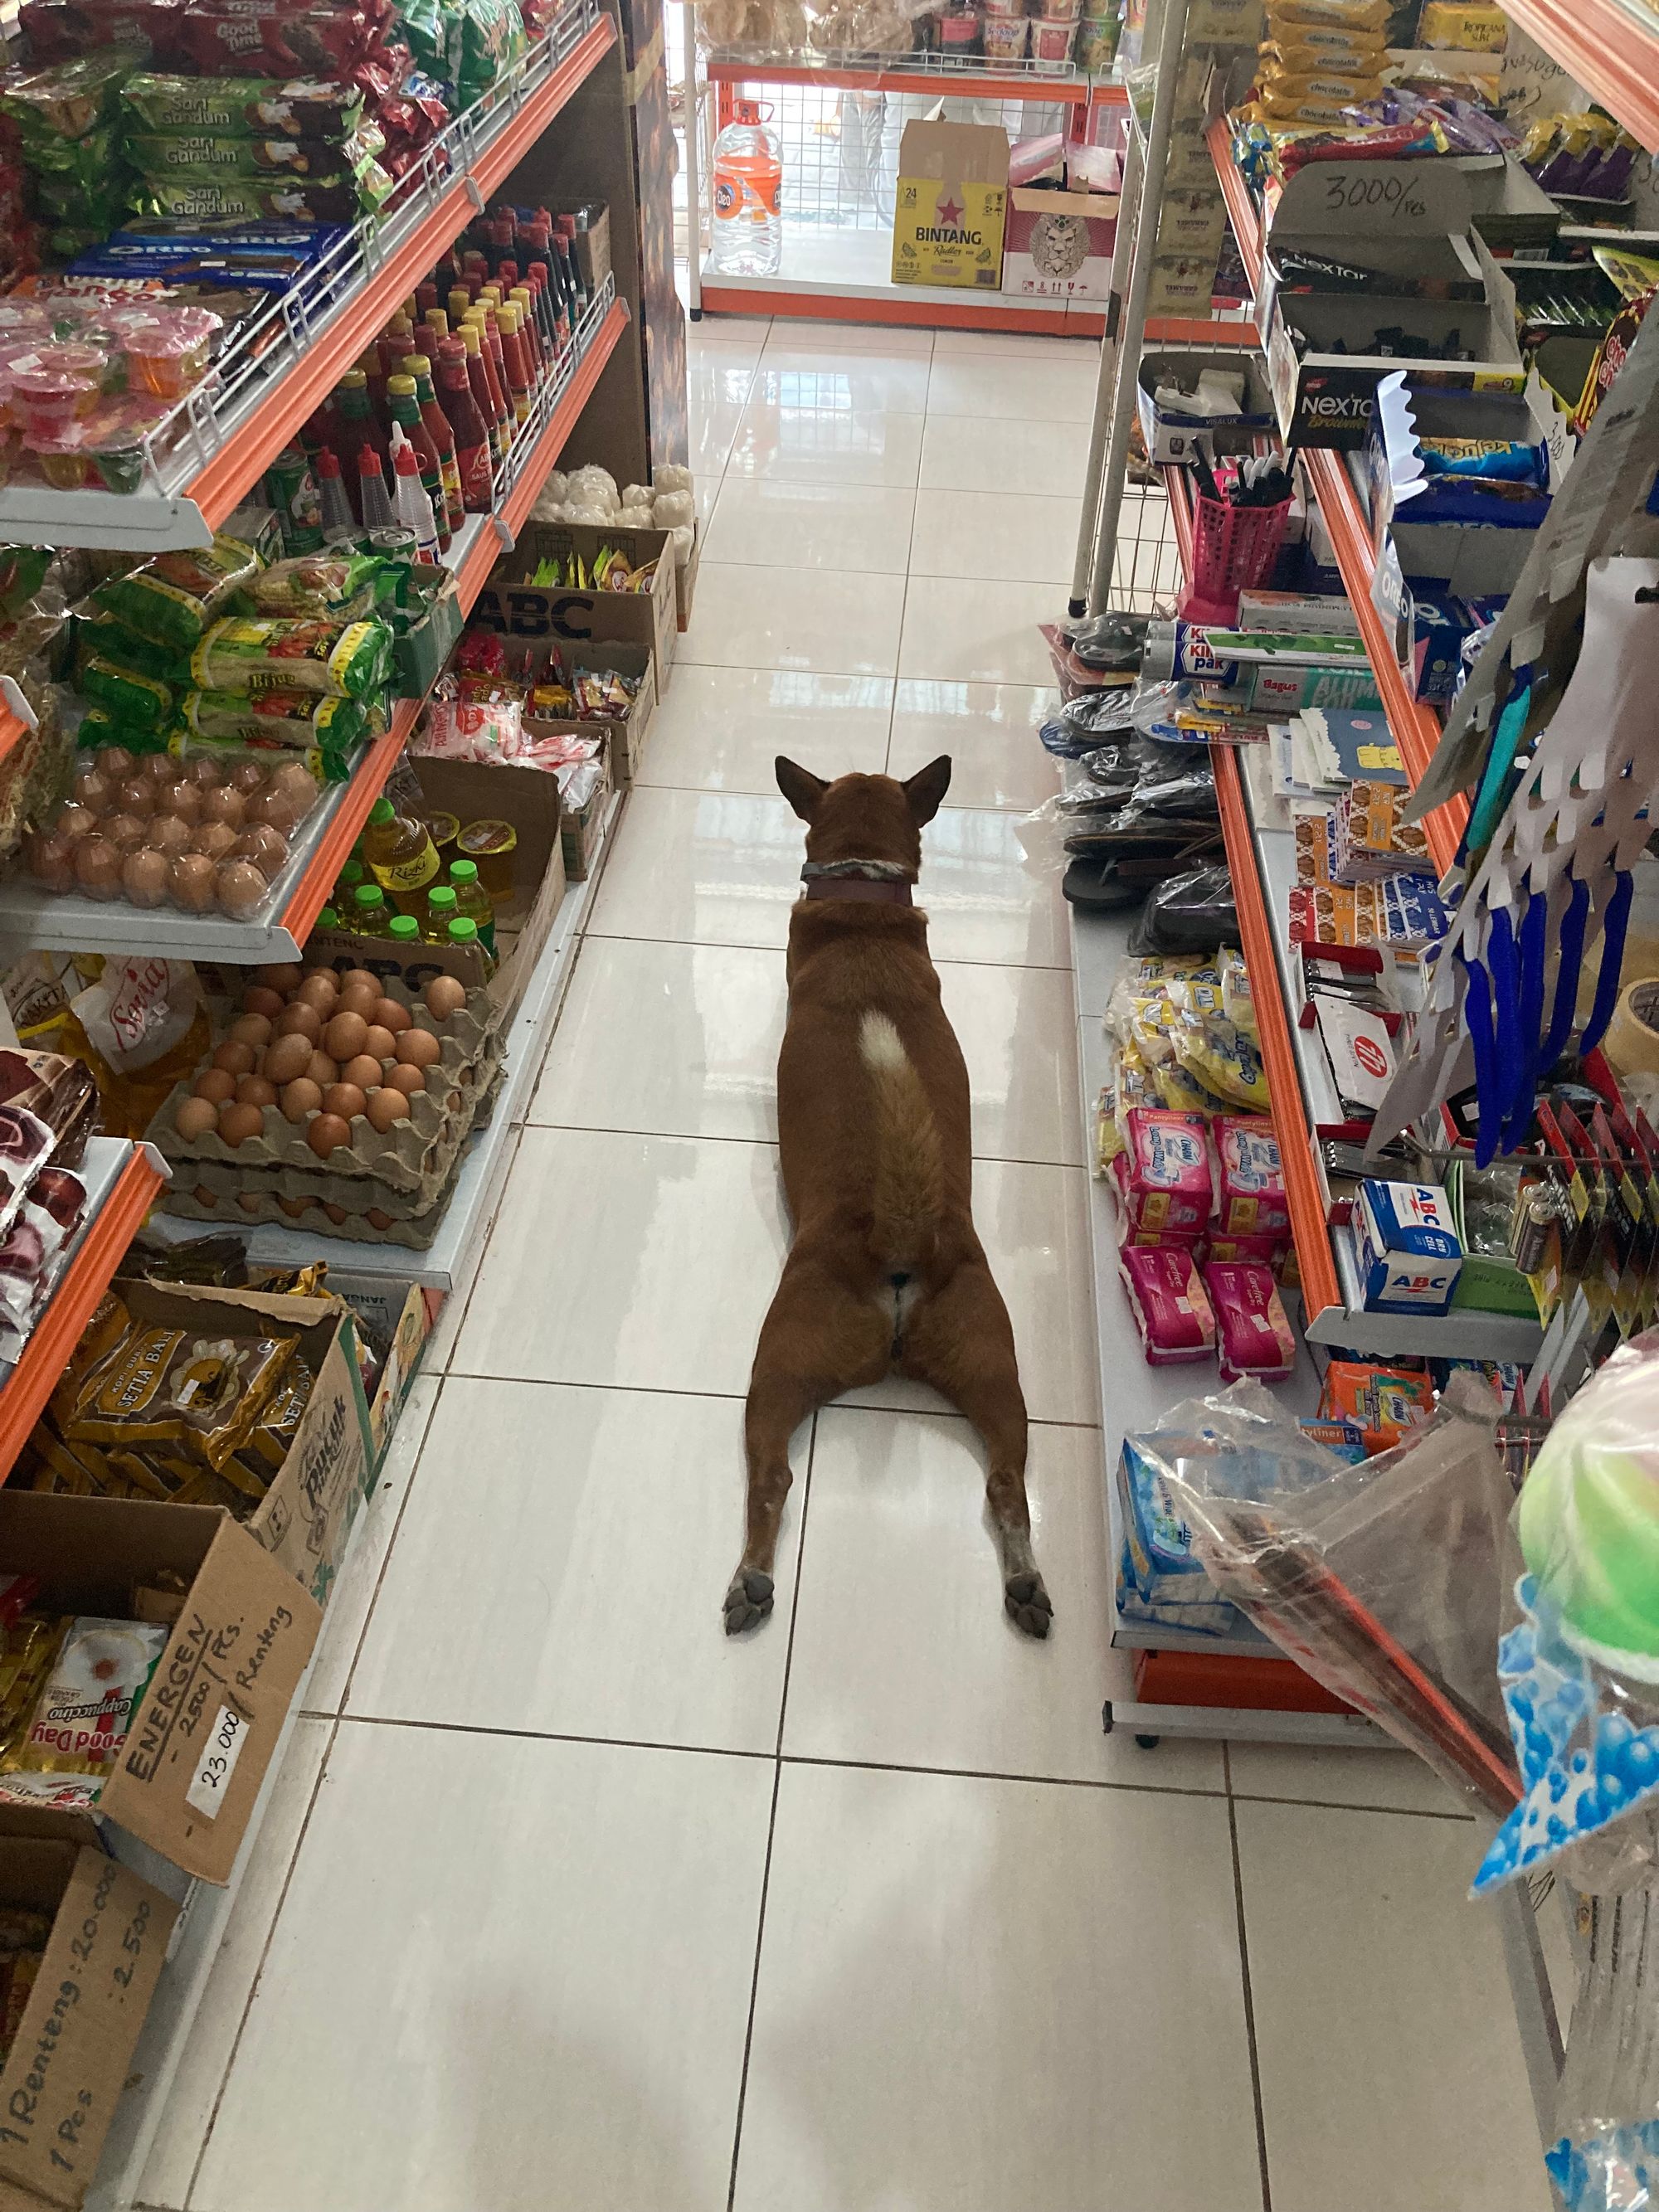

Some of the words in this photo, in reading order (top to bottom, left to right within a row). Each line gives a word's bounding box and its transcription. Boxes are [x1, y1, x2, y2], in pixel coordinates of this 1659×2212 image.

[216, 19, 260, 39] Good
[167, 147, 238, 165] Gandum
[185, 185, 221, 202] Sari
[716, 189, 731, 207] Cleo
[906, 187, 917, 200] 24
[171, 197, 246, 216] Gandum
[915, 226, 982, 246] BINTANG
[1205, 416, 1238, 425] VISALUX
[474, 591, 595, 639] ABC
[1194, 657, 1224, 671] pak
[1262, 678, 1298, 693] Bagus
[389, 853, 427, 880] Rizki
[1149, 1126, 1161, 1145] Long
[1235, 1130, 1248, 1150] Long
[1152, 1150, 1165, 1169] Wide
[1180, 1139, 1194, 1160] CHARM
[1267, 1145, 1282, 1164] CHARM
[1416, 1187, 1441, 1227] ABC
[1423, 1235, 1433, 1251] CELL
[1434, 1237, 1447, 1254] DRY
[1165, 1252, 1184, 1287] Carefree
[1247, 1270, 1265, 1307] Carefree
[1391, 1275, 1447, 1289] ABC
[116, 1368, 155, 1408] SETIA
[145, 1329, 177, 1364] BALI
[1501, 1361, 1516, 1386] CHARM
[1392, 1397, 1406, 1421] CHARM
[236, 1606, 293, 1690] Renteng
[124, 1614, 210, 1782] ENERGEN
[48, 1697, 134, 1722] Cappuccino
[30, 1719, 72, 1753] Day
[201, 1710, 241, 1788] 23.000
[8, 1979, 81, 2126] Renteng
